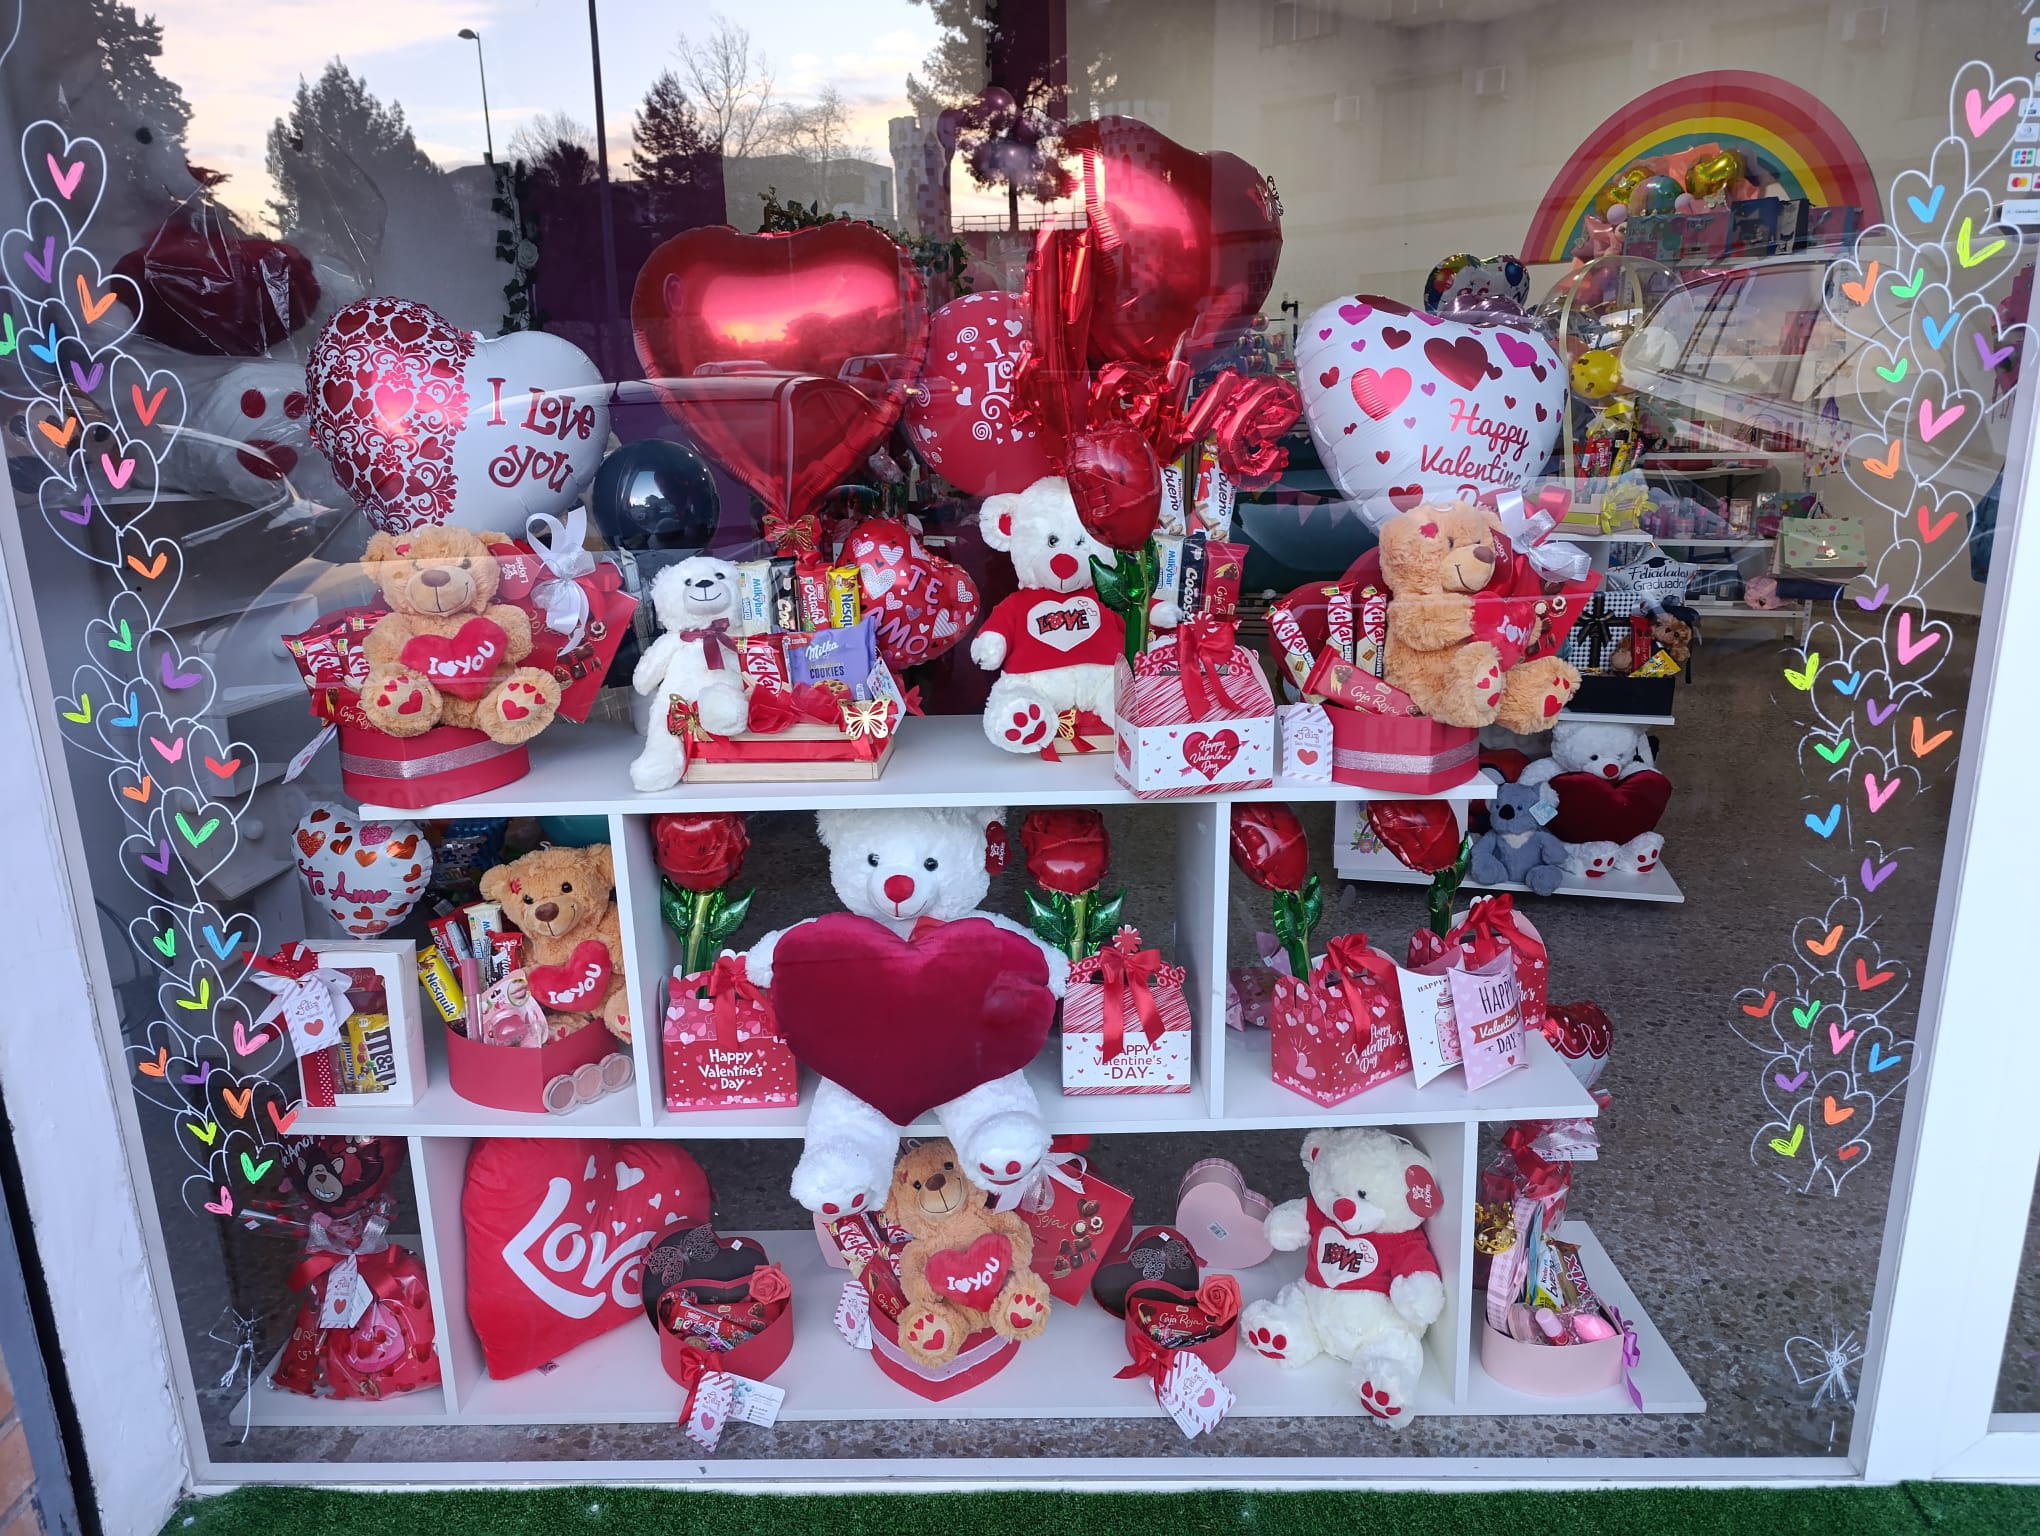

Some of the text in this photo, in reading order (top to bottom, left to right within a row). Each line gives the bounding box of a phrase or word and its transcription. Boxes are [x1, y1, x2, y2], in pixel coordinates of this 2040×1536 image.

[987, 338, 1005, 360] I
[487, 377, 596, 440] I Love
[1449, 398, 1530, 462] Happy
[1163, 468, 1179, 511] bueno
[1165, 550, 1177, 587] Milkybar
[752, 578, 763, 617] Milkybar
[908, 564, 945, 605] TE
[1036, 610, 1091, 635] LOVE
[1273, 615, 1309, 655] KitKat
[1328, 601, 1352, 643] KitKat
[429, 640, 495, 675] I YOU
[805, 641, 839, 661] Milka
[810, 666, 845, 679] COOKIES
[1351, 686, 1400, 715] Caja Roja
[356, 712, 374, 730] Roj
[1190, 751, 1231, 763] Valentine's
[1198, 740, 1227, 755] Happy
[1201, 761, 1219, 774] Day
[328, 871, 392, 904] Amo
[425, 972, 458, 1017] Nesquik
[548, 963, 602, 1005] I YOU
[1417, 979, 1442, 993] HAPPY
[1479, 978, 1515, 1015] HAPPY
[1480, 1009, 1520, 1039] Valentine's
[709, 1048, 753, 1065] Happy
[1121, 1044, 1151, 1056] APPY
[1497, 1032, 1517, 1055] DAY
[698, 1063, 763, 1078] Valentine's
[1093, 1056, 1162, 1066] Vlentine's
[721, 1077, 745, 1091] Day
[946, 1256, 1000, 1291] I YOU
[1159, 1312, 1203, 1328] Caja Roja
